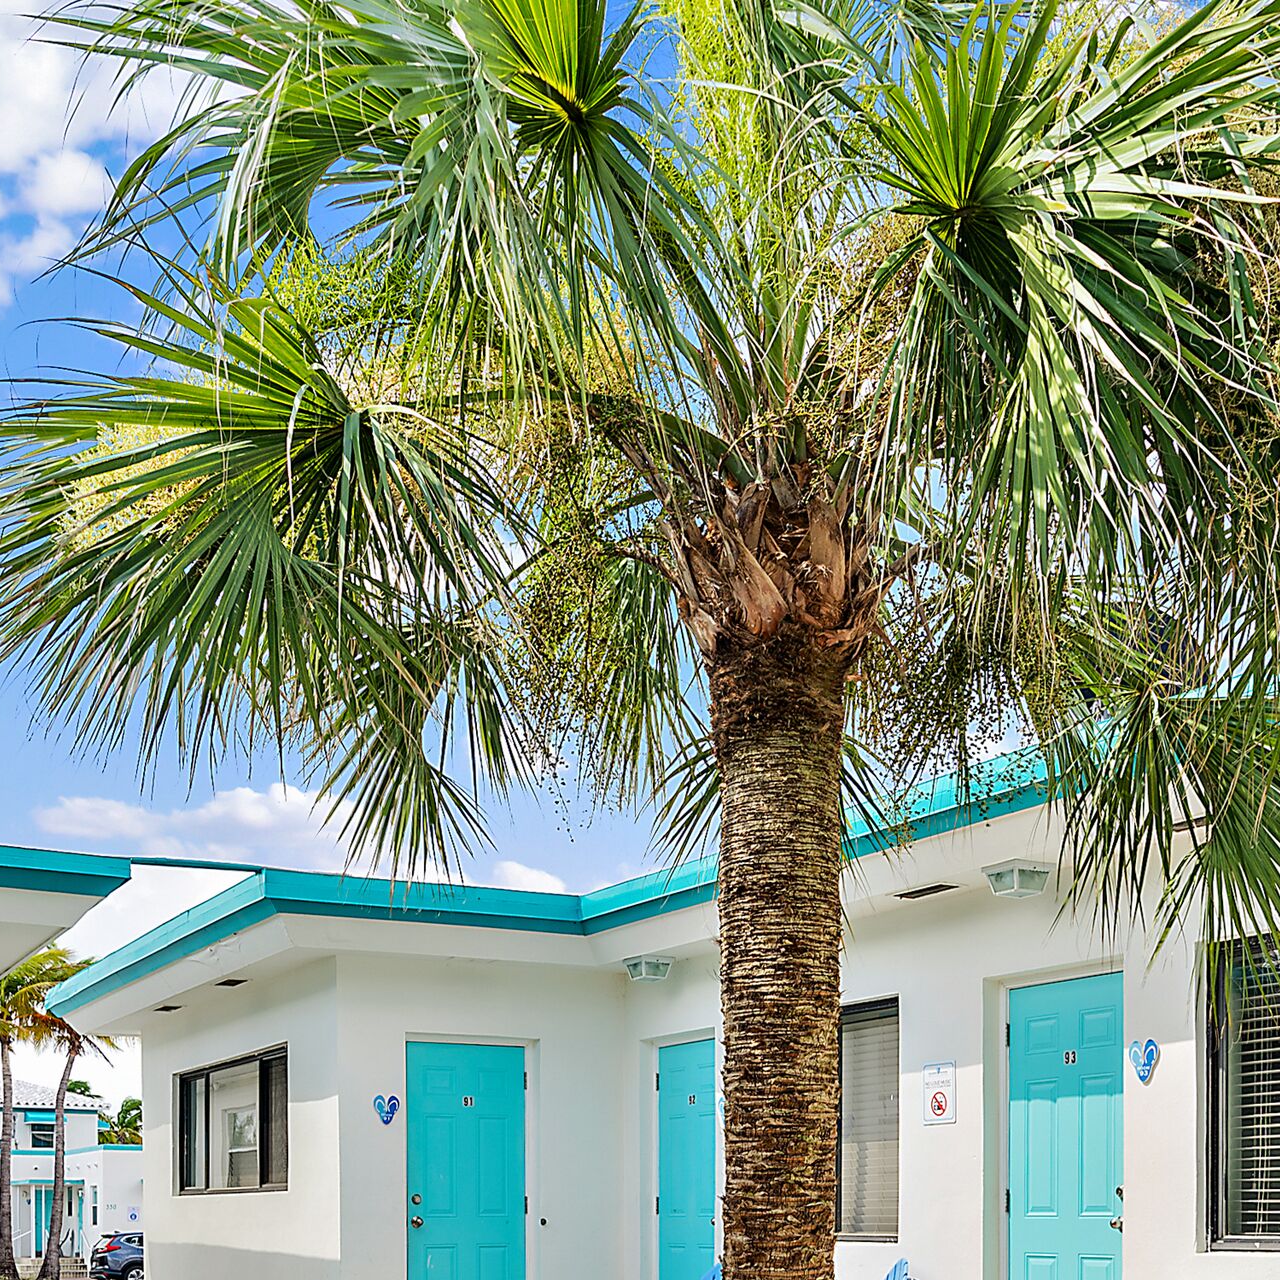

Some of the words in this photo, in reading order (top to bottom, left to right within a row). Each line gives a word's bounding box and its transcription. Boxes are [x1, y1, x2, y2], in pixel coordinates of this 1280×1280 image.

[1064, 1051, 1076, 1064] 93
[463, 1097, 473, 1106] 91
[689, 1095, 696, 1105] 92
